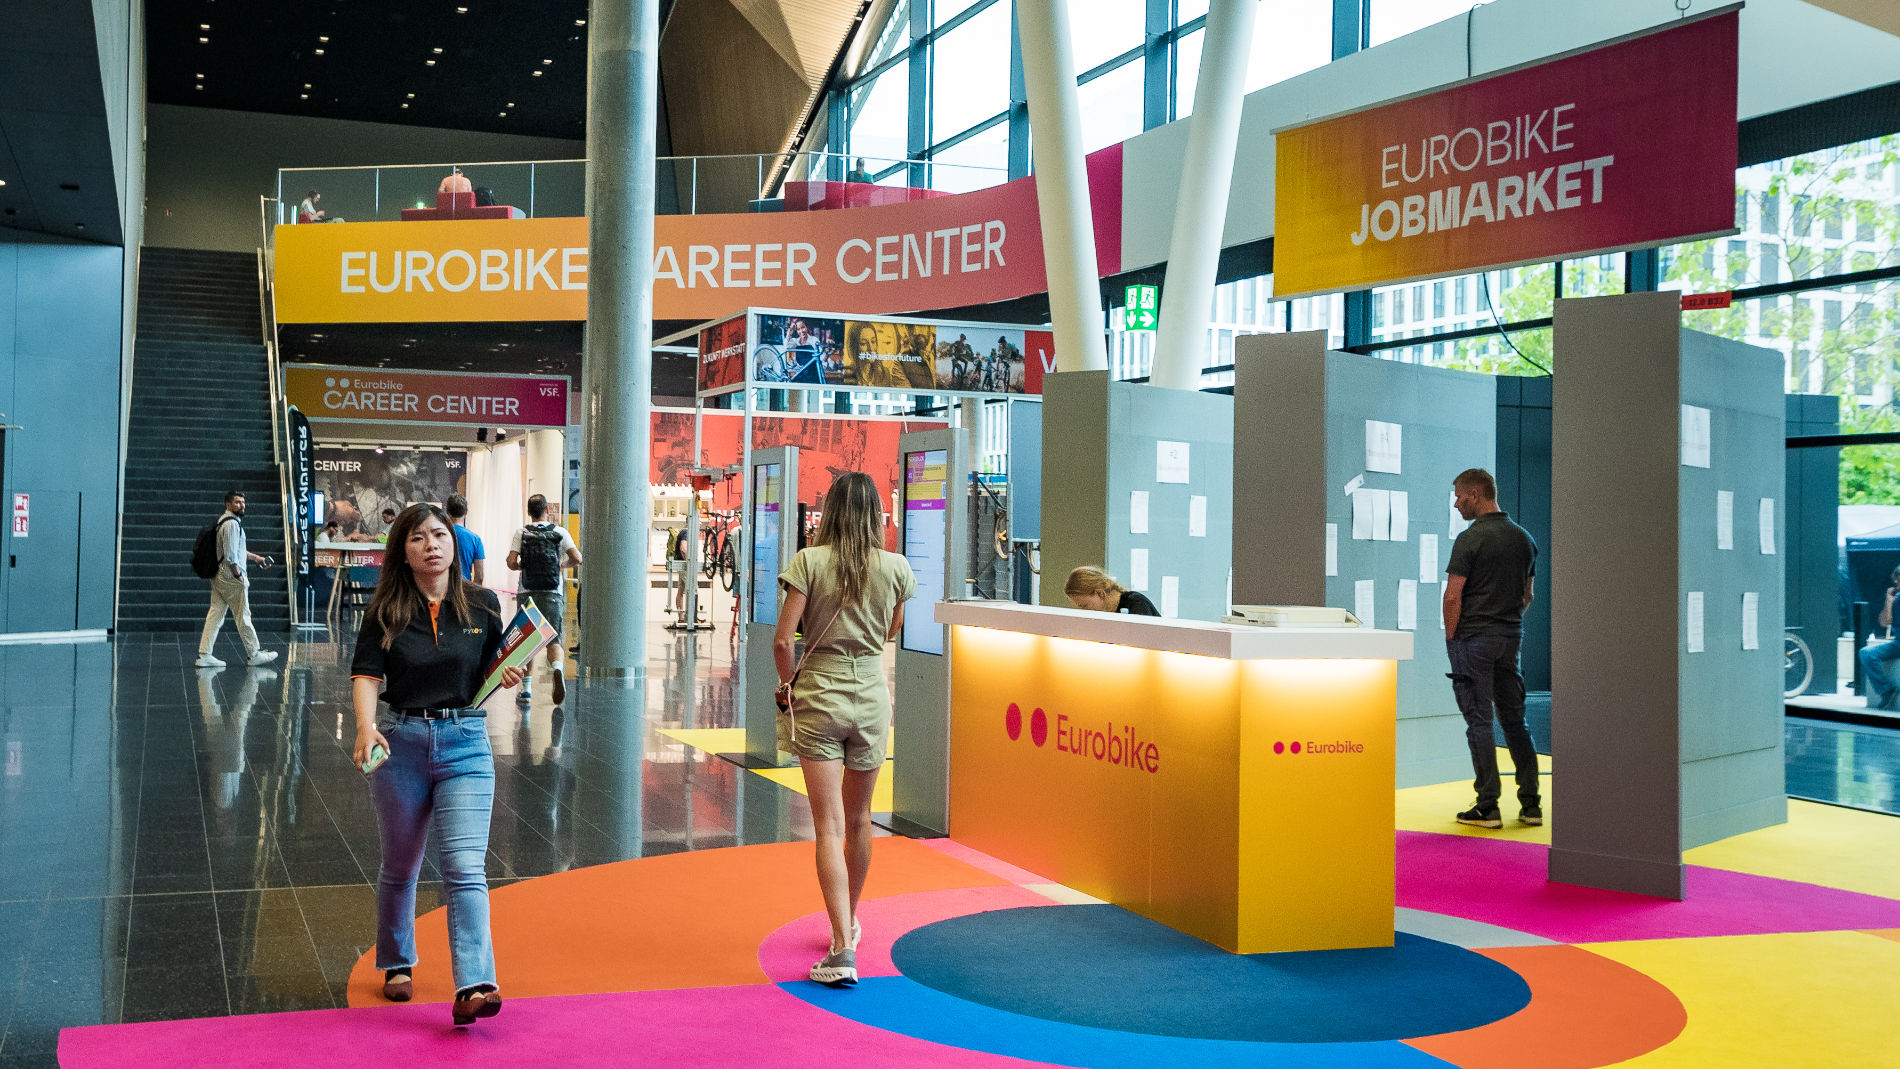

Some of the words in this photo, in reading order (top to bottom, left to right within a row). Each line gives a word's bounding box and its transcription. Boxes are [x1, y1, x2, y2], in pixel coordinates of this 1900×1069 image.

[1381, 103, 1575, 189] EUROBIKE
[1350, 155, 1615, 246] JOBMARKET
[340, 247, 588, 293] EUROBIKE
[651, 242, 818, 288] AREER
[836, 219, 1007, 284] CENTER
[859, 351, 923, 363] #bikesforfuture
[353, 378, 404, 391] Eurobike
[323, 390, 419, 412] CAREER
[426, 394, 520, 416] CENTER
[314, 460, 362, 472] CENTER
[1056, 713, 1160, 775] Eurobike
[1306, 740, 1364, 755] Eurobike
